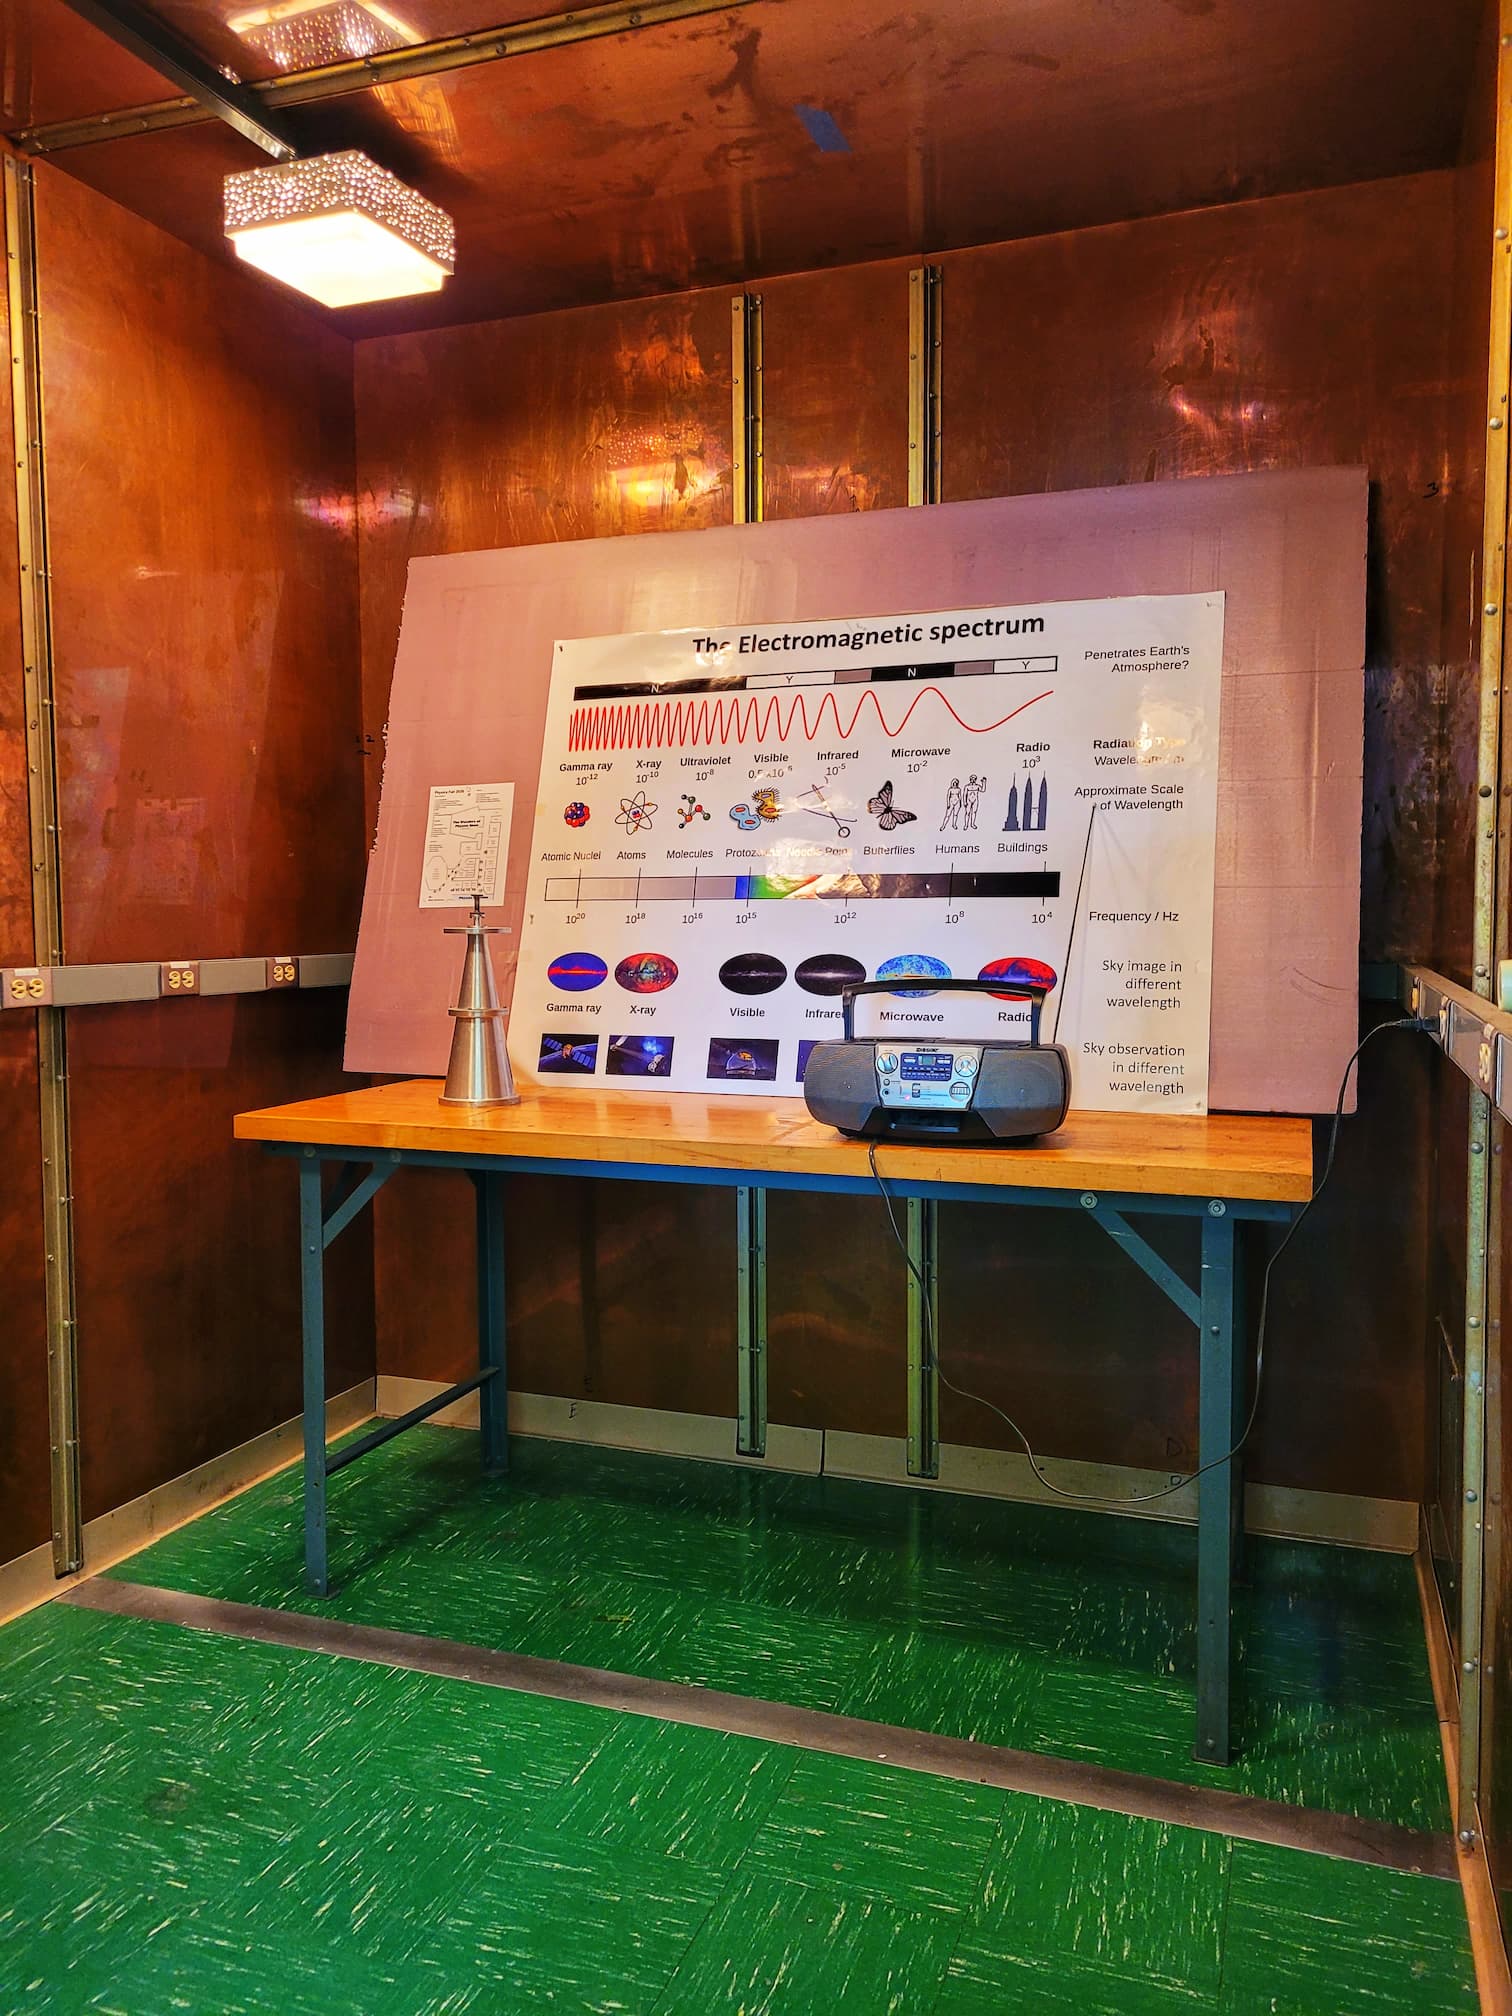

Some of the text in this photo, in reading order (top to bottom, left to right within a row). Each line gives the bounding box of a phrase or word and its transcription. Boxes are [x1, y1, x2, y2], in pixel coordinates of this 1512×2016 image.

[738, 622, 923, 653] Electromagnetic
[929, 616, 1046, 643] spectrum
[1085, 645, 1190, 660] Penetrates Earth's
[1021, 660, 1031, 670] Y
[1111, 660, 1190, 673] Atmosphere?
[907, 667, 917, 677] N
[786, 675, 794, 684] Y
[891, 746, 951, 758] Microwave
[1016, 741, 1051, 752] Radio
[680, 756, 732, 767] Ultraviolet
[753, 753, 789, 763] Visible
[817, 750, 859, 761] Infrared
[559, 761, 613, 772] Gamma ray
[635, 759, 662, 769] X-ray
[1074, 784, 1184, 799] Approximate Scale
[1100, 799, 1184, 812] of Wavelength
[666, 849, 714, 859] Molecules
[863, 845, 915, 856] Butterflies
[935, 844, 981, 854] Humans
[997, 842, 1048, 854] Buildings
[541, 851, 602, 861] Atomic Nuclei
[616, 850, 647, 860] Atoms
[1089, 911, 1152, 924] Frequency
[1162, 911, 1180, 922] Hz
[1102, 959, 1182, 974] Sky image in
[1125, 977, 1182, 990] different
[546, 1002, 602, 1014] Gamma ray
[1106, 996, 1181, 1010] wavelength
[629, 1004, 657, 1016] X-ray
[729, 1007, 765, 1018] Visible
[805, 1008, 844, 1019] Infrare
[879, 1010, 945, 1023] Microwave
[1083, 1042, 1185, 1057] Sky observation
[1112, 1061, 1185, 1075] in different
[1109, 1080, 1184, 1095] wavelength
